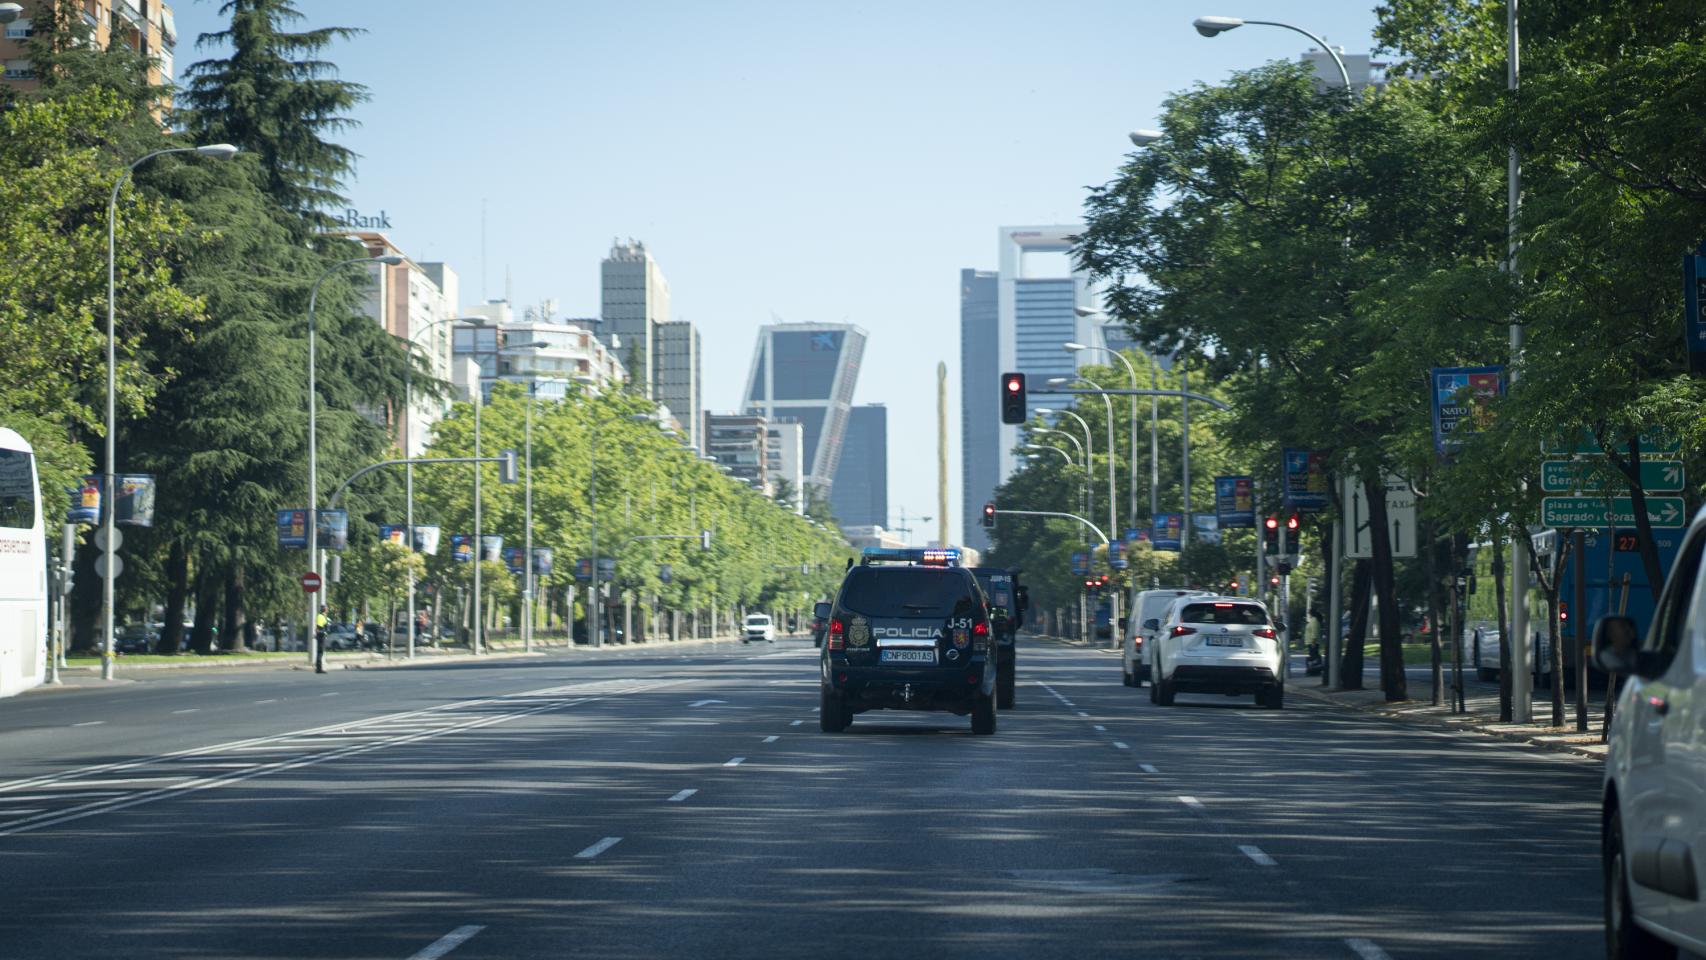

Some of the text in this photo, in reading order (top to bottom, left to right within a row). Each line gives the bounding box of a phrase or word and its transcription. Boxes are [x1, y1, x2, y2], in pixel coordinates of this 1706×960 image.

[1442, 407, 1467, 415] NATO
[1620, 537, 1636, 550] 27
[947, 618, 973, 629] J-51
[873, 626, 943, 638] POLICÍA
